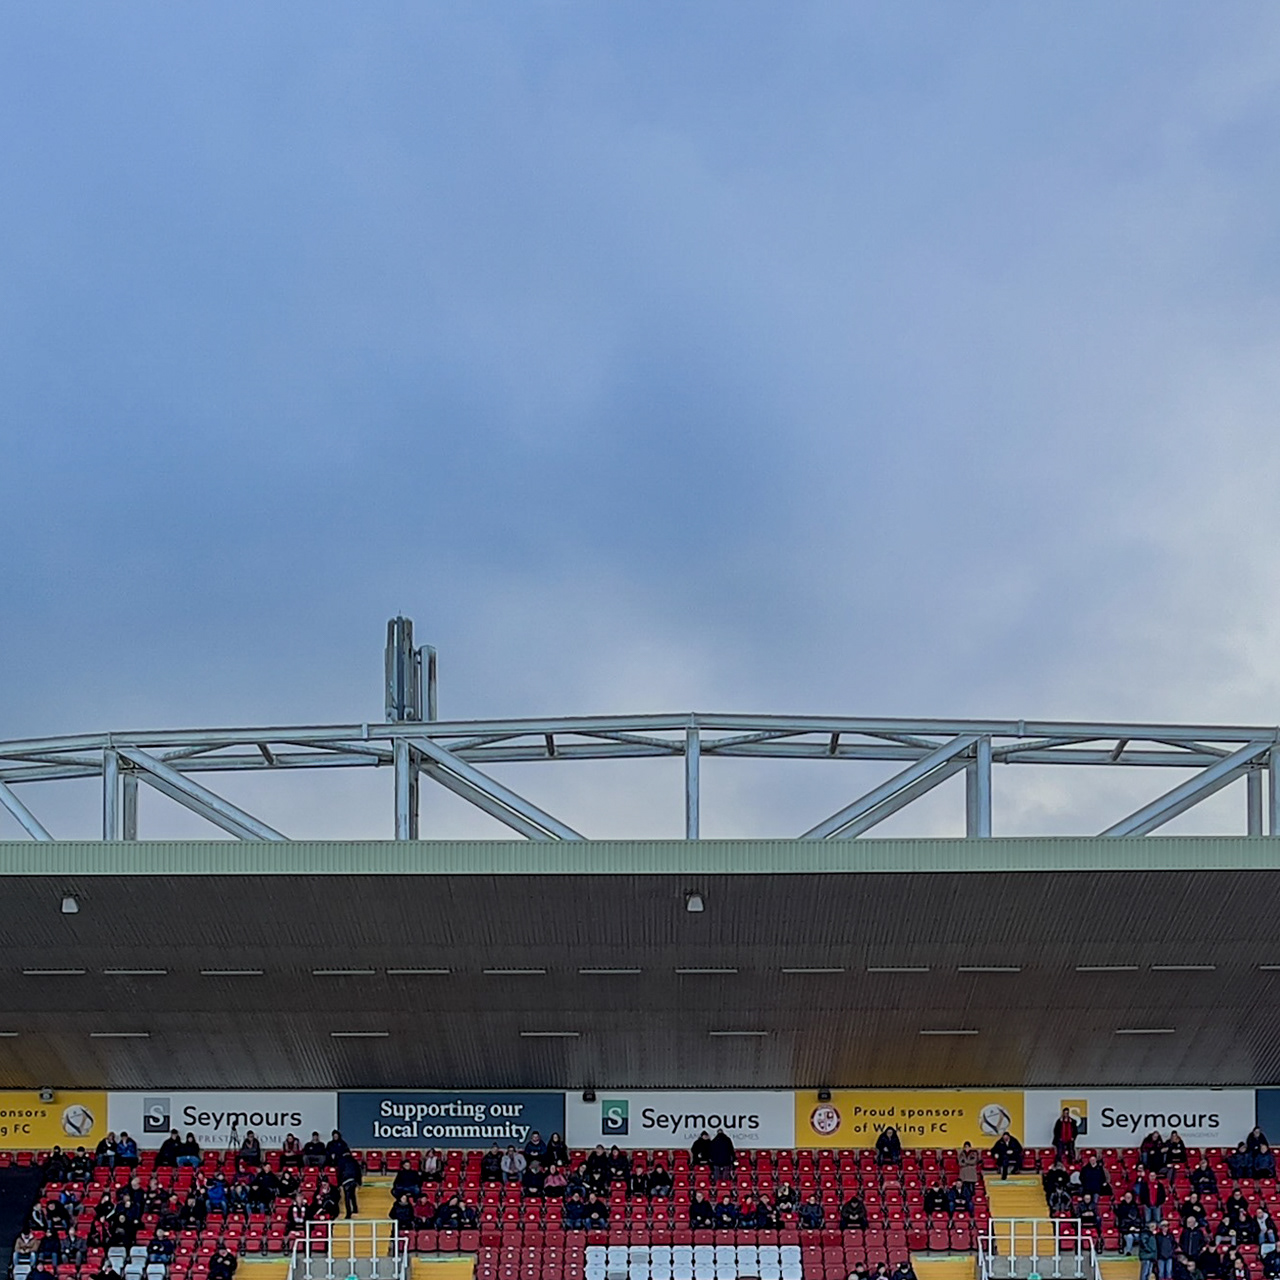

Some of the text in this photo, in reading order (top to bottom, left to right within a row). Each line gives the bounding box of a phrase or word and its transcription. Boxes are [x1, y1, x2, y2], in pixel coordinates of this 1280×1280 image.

[183, 1105, 303, 1131] Seymours
[380, 1099, 523, 1122] Supporting our
[641, 1107, 760, 1133] Seymours
[854, 1106, 964, 1119] Proud sponsors
[1100, 1107, 1220, 1133] Seymours
[14, 1124, 31, 1134] FC
[373, 1121, 530, 1143] local community
[854, 1122, 868, 1134] of
[931, 1123, 948, 1134] FC
